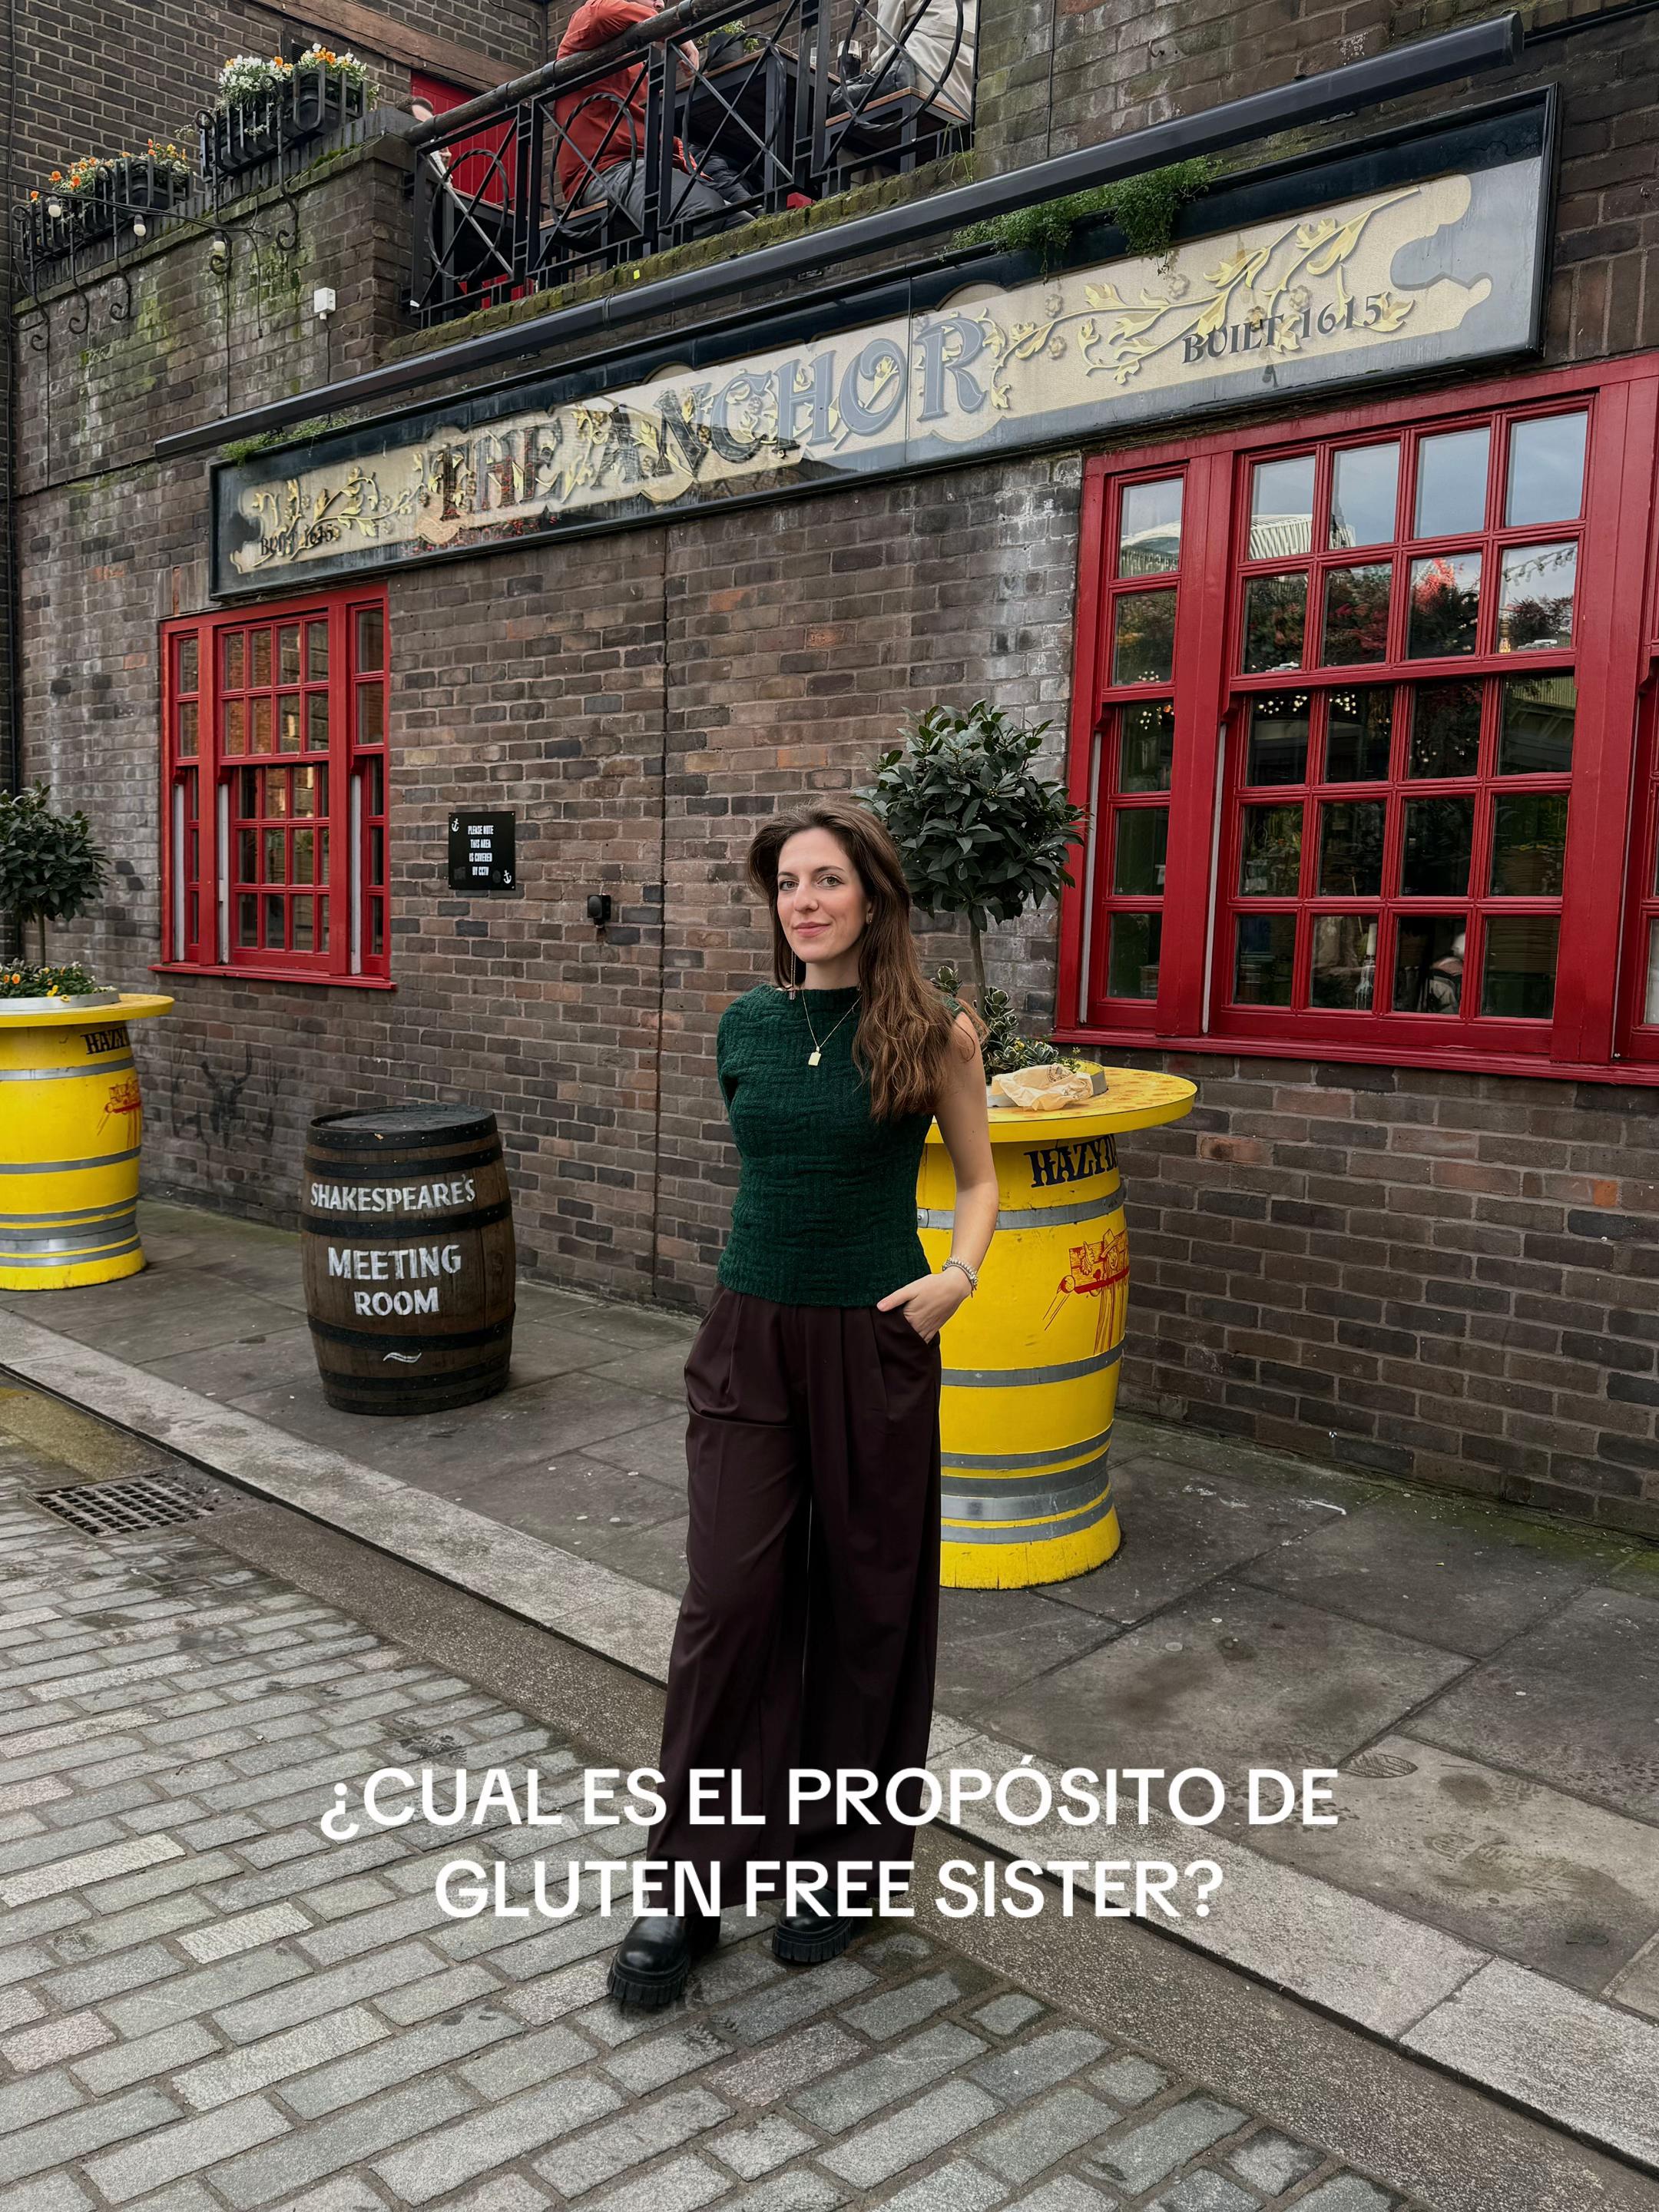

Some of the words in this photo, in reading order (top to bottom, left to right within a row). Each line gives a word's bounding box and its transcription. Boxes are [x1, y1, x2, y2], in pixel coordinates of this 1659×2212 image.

[1182, 313, 1284, 364] BUILT
[1300, 292, 1386, 339] 1615
[427, 418, 563, 522] THE
[588, 316, 987, 492] ANCHOR
[468, 825, 482, 835] PLEASE
[310, 1174, 475, 1211] SHAKESPEARE'S
[328, 1244, 461, 1280] MEETING
[354, 1287, 439, 1316] ROOM
